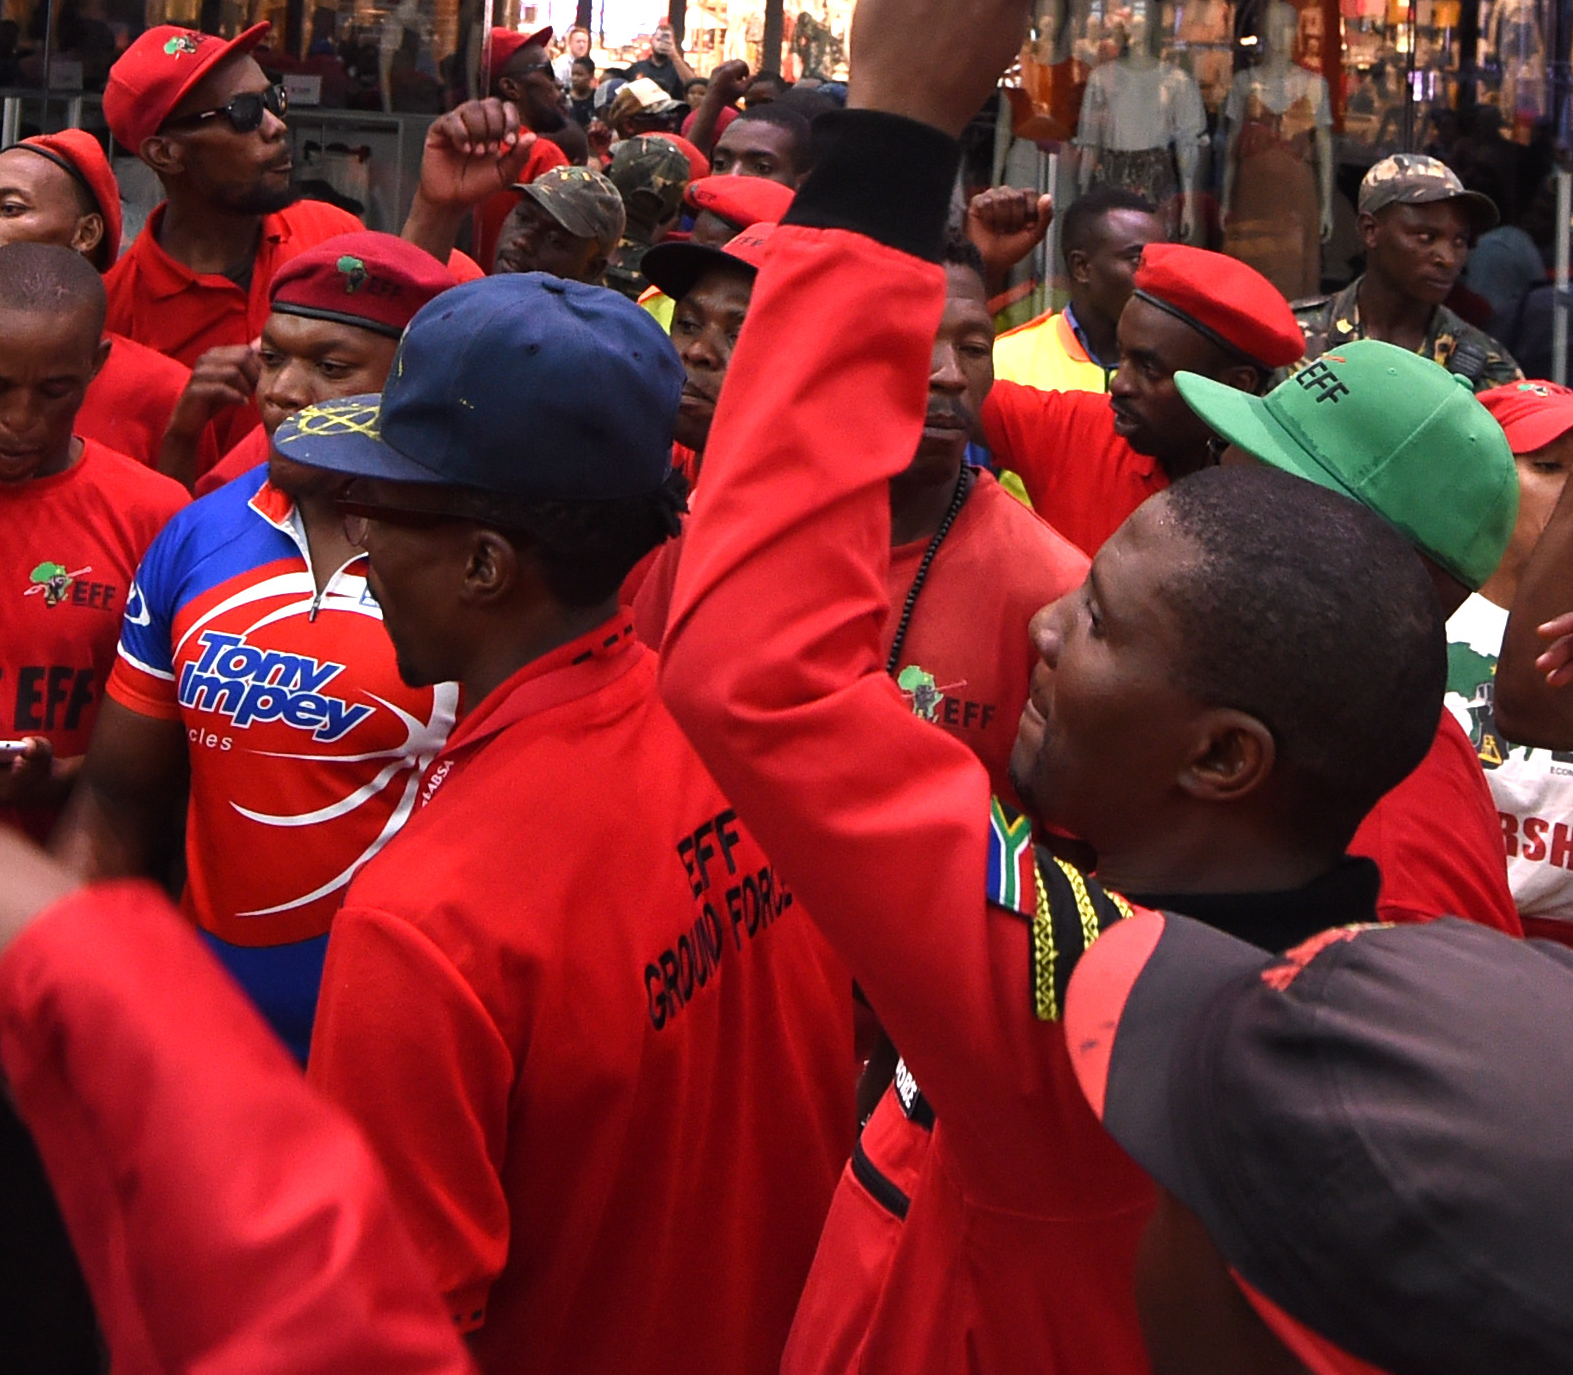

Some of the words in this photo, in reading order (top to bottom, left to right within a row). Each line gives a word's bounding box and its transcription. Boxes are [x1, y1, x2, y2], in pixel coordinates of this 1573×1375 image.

[1295, 360, 1350, 403] EFF
[72, 580, 116, 611] EFF
[197, 630, 346, 693] Tony
[13, 666, 95, 731] EFF
[178, 660, 376, 743] Impey
[944, 696, 996, 729] EFF
[188, 728, 233, 751] cles
[677, 808, 739, 900] EFF
[644, 902, 723, 1031] GROUND
